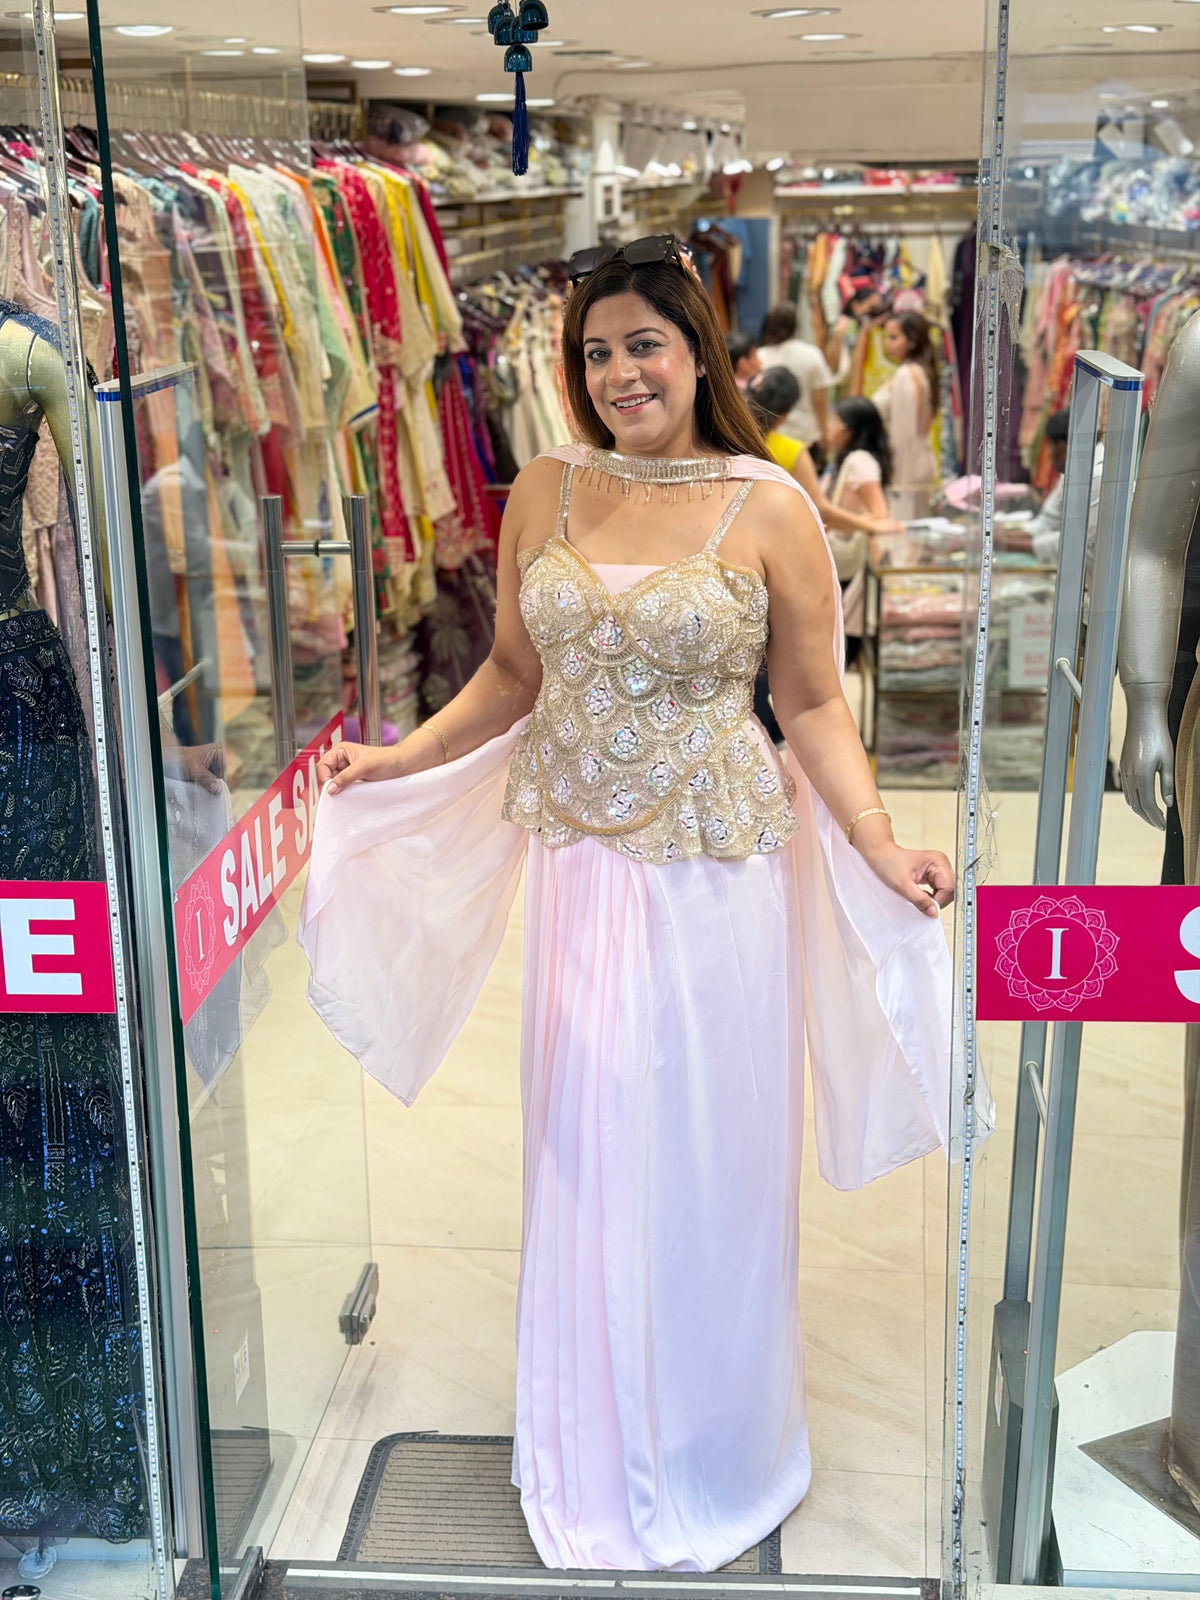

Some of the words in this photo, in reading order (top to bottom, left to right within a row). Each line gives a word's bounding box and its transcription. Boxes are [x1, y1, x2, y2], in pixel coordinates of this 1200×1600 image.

[220, 791, 287, 947] SALE
[292, 724, 343, 856] SA
[1043, 927, 1070, 980] I
